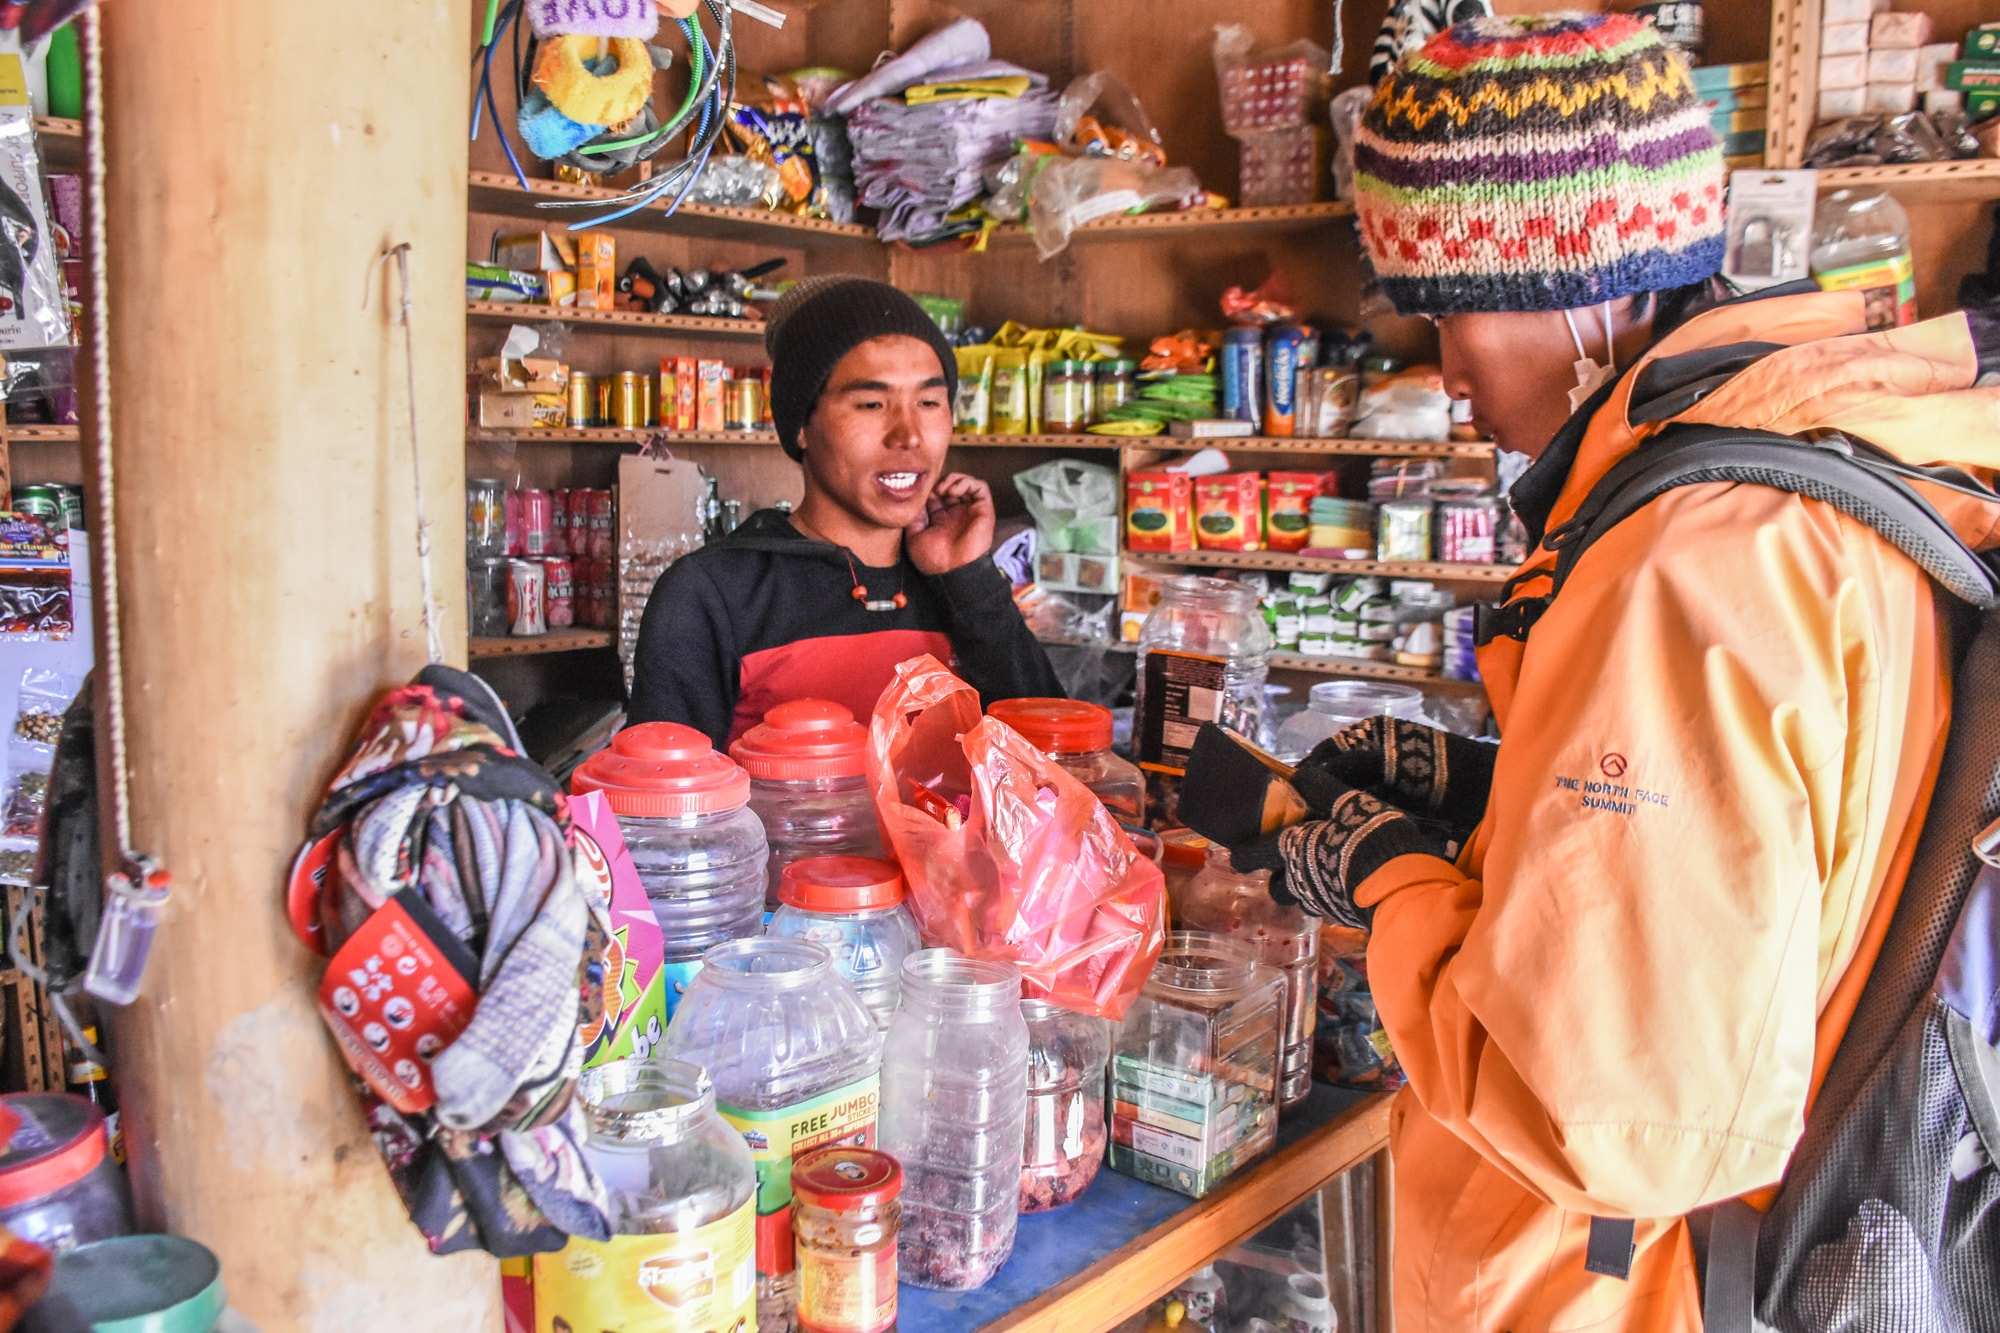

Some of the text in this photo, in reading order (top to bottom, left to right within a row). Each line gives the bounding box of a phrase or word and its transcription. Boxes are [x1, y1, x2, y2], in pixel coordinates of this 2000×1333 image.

[1555, 776, 1669, 808] THE NORTH FACE
[1582, 795, 1637, 816] SUMMIT
[791, 1113, 828, 1139] FREE
[830, 1091, 877, 1121] JUMBO
